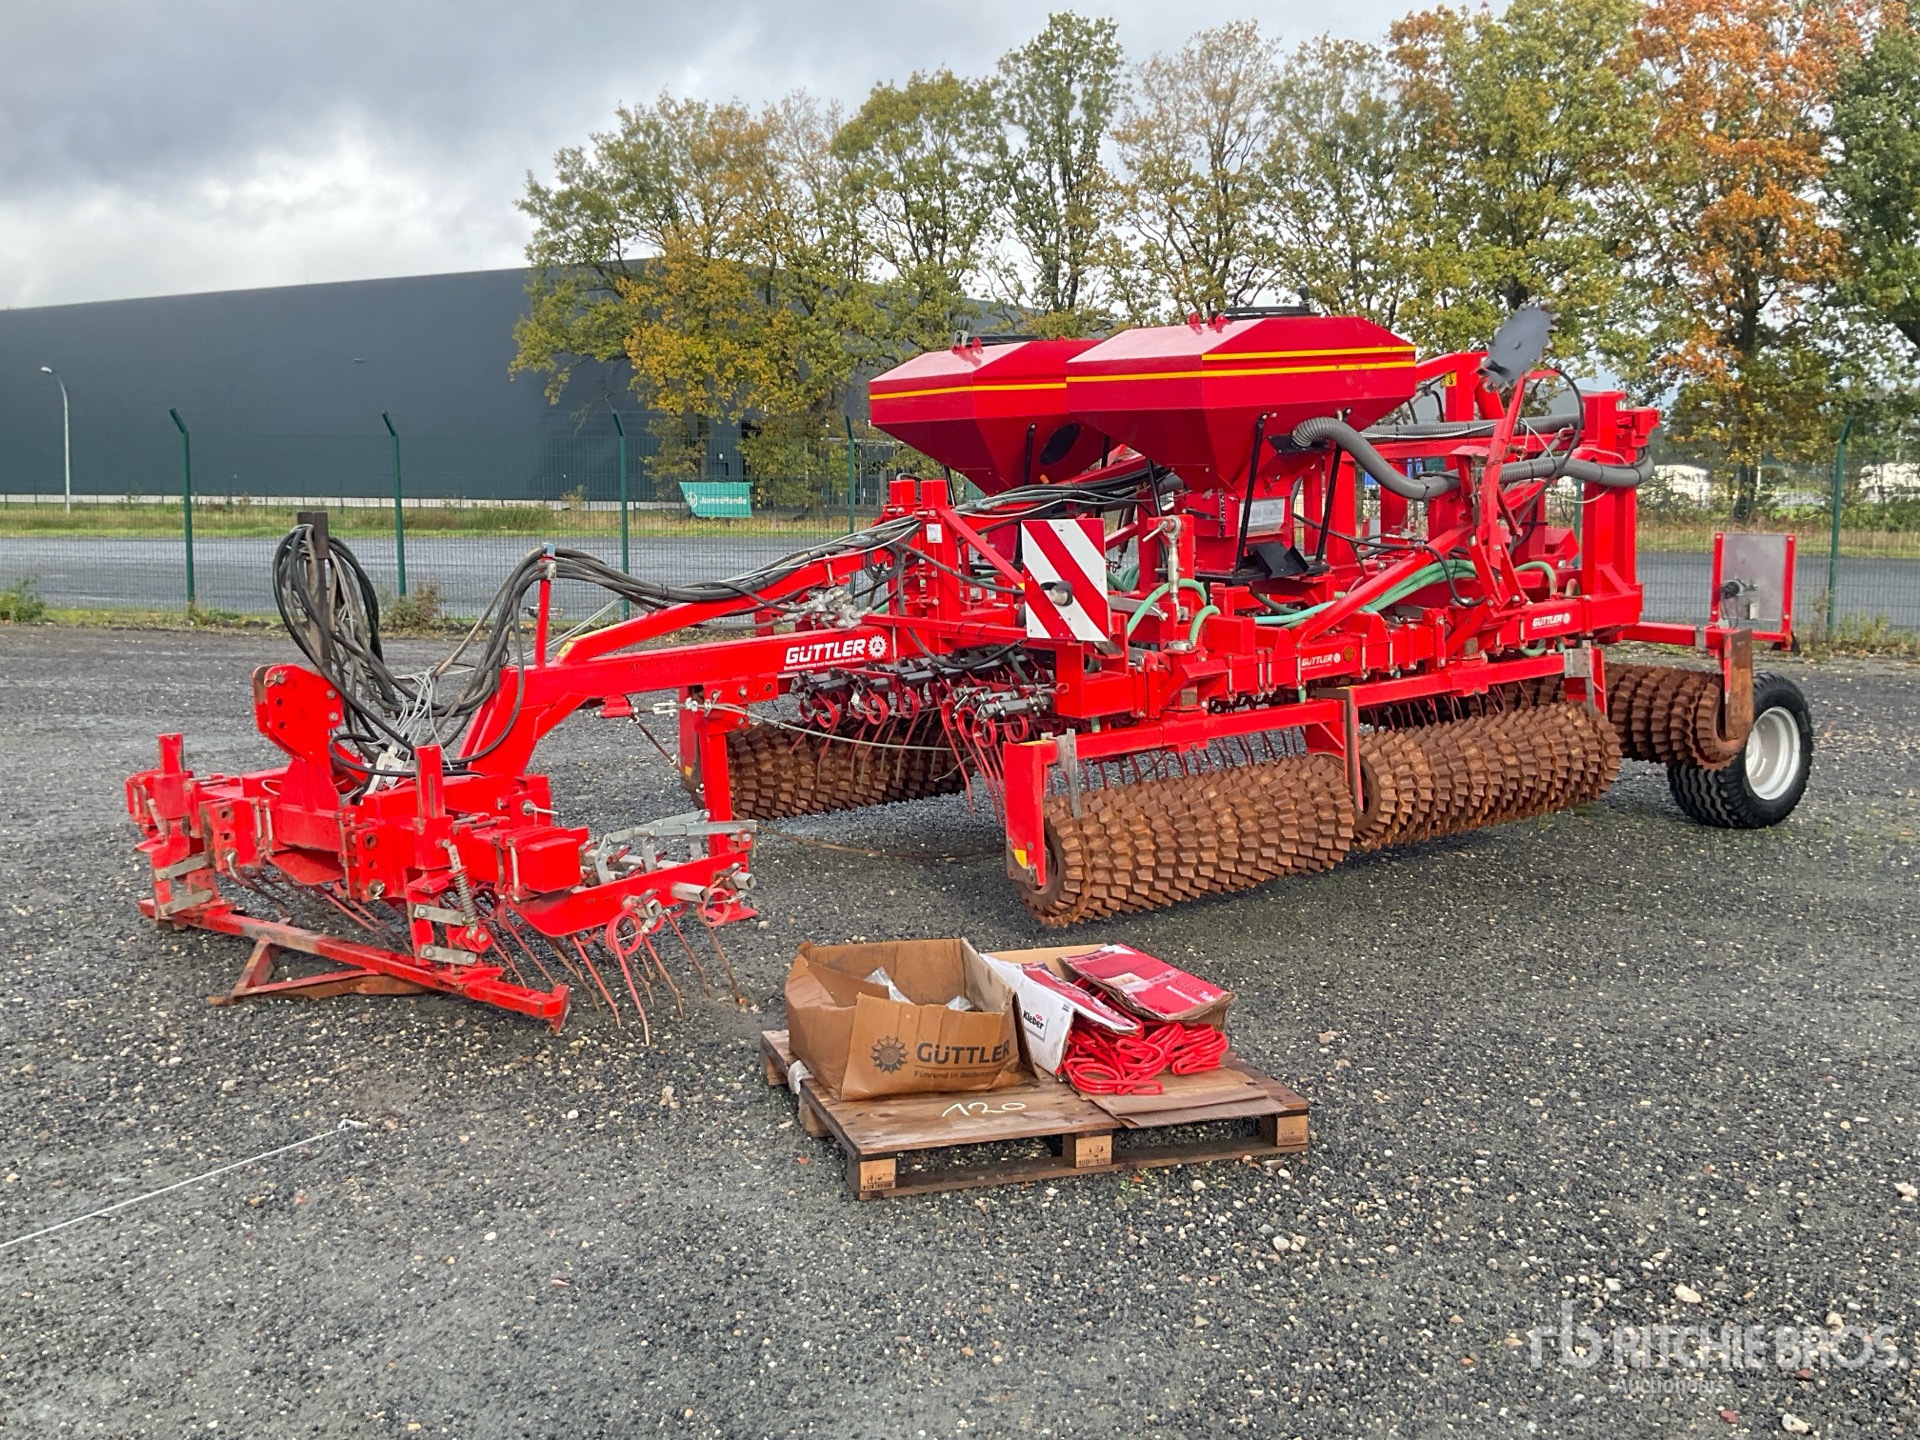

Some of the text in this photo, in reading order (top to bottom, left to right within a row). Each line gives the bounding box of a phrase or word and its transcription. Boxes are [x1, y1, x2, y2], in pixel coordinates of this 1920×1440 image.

[785, 639, 867, 665] GÜTTLER
[1023, 1009, 1044, 1030] Kleber
[916, 1039, 1011, 1065] GÜTTLER
